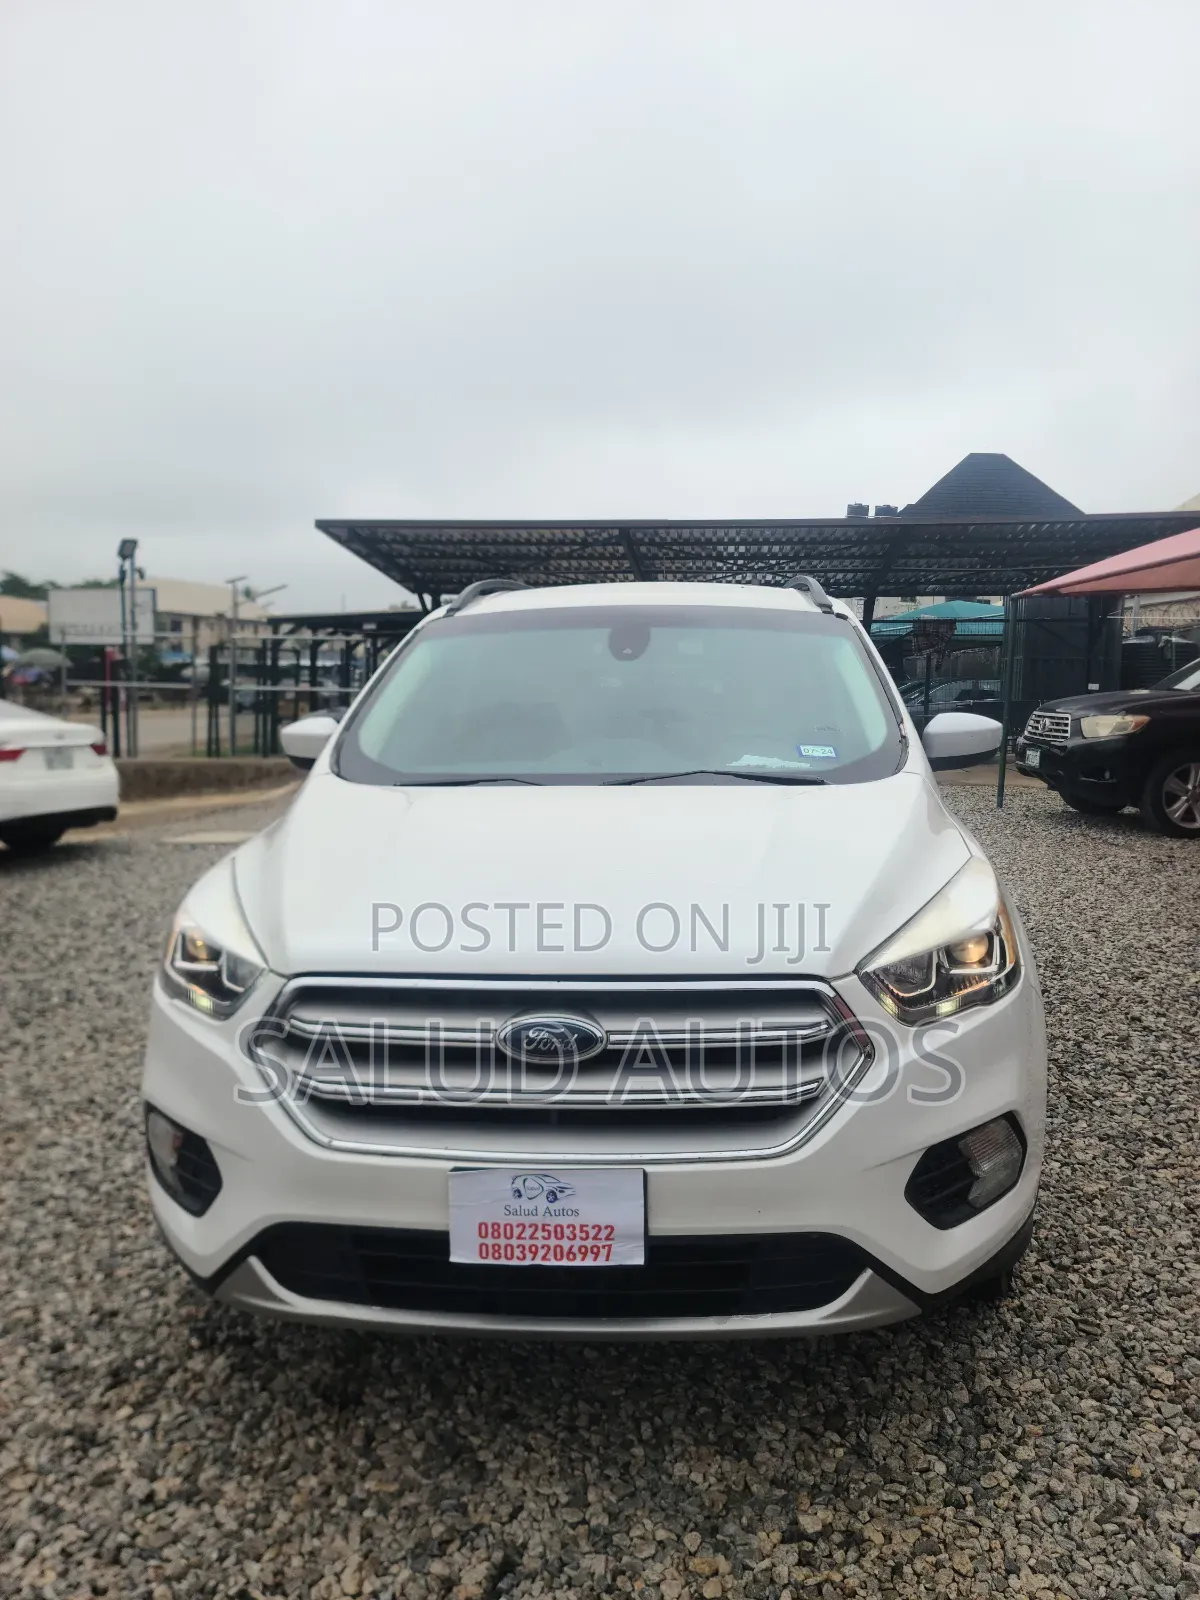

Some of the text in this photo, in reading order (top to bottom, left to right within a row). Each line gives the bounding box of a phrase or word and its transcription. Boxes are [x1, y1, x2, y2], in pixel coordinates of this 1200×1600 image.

[523, 1026, 578, 1051] Ford
[503, 1204, 580, 1217] Salud Autos
[478, 1221, 615, 1241] 08022503522
[478, 1242, 613, 1262] 08039206997
